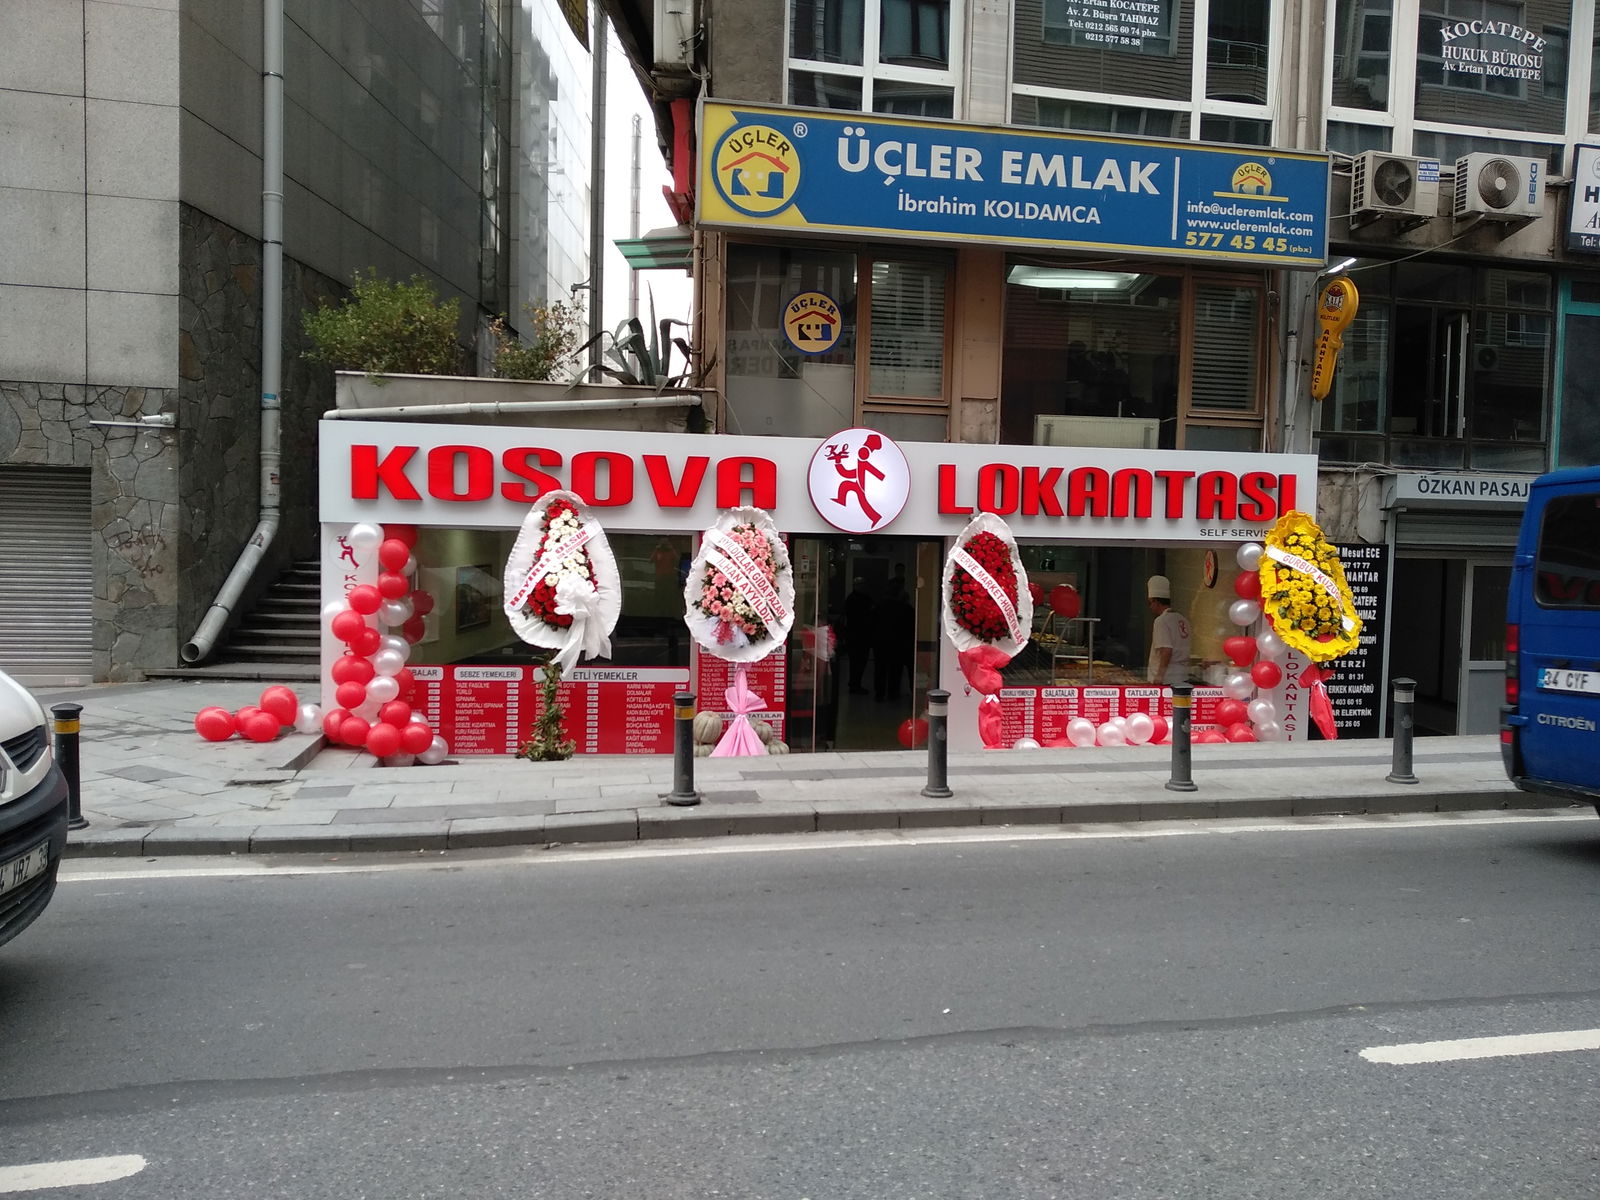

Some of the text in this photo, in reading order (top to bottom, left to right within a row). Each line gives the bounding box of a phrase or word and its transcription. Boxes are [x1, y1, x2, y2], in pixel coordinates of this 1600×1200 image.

[1067, 6, 1081, 16] Av.
[1083, 8, 1090, 17] Z.
[1120, 13, 1159, 26] TAHMAZ
[1110, 0, 1160, 14] KOCATEPE
[1068, 19, 1084, 28] Tel:
[1085, 21, 1103, 31] 0212
[1120, 25, 1129, 34] 60
[1131, 26, 1140, 35] 74
[1141, 29, 1157, 38] pbx
[1439, 20, 1547, 53] KOCATEPE
[1085, 32, 1141, 46] 0212 577 58 38
[1441, 45, 1543, 69] HUKUK BÜROSU
[1442, 60, 1541, 80] Av. Ertan KOCATEPE
[728, 131, 790, 157] ÜÇLER
[837, 126, 1160, 195] ÜÇLER EMLAK
[1238, 164, 1268, 178] ÜÇLER
[1527, 162, 1538, 205] BEKO
[898, 190, 1101, 224] İbrahim KOLDAMCA
[1187, 200, 1313, 222] info@ucleremlak.com
[1187, 219, 1313, 236] www.ucleremlak.com
[1185, 231, 1313, 254] 577 45 45 (pbx)
[790, 297, 837, 316] ÜÇLER
[351, 444, 778, 510] KOSOVA
[1417, 475, 1528, 498] ÖZKAN PASAJ
[937, 462, 1298, 522] LOKANTASI
[554, 529, 588, 555] OLSUN
[1200, 528, 1227, 538] SELF
[956, 551, 980, 573] MERVE
[1342, 547, 1364, 558] Mesut
[1366, 547, 1380, 558] ECE
[1346, 571, 1379, 582] NAHTAR
[739, 581, 774, 625] AYYILDIZ
[751, 572, 769, 594] GIDA
[765, 591, 788, 620] PAZARI
[1353, 596, 1378, 606] CATEPE
[1334, 659, 1366, 668] TERZİ
[573, 669, 638, 680] ETLİ YEMEKLER
[1283, 652, 1299, 742] LOKANTASI
[1328, 685, 1347, 694] ERKEK
[1341, 707, 1372, 717] ELEKTRİK
[1536, 713, 1596, 732] CITROËN
